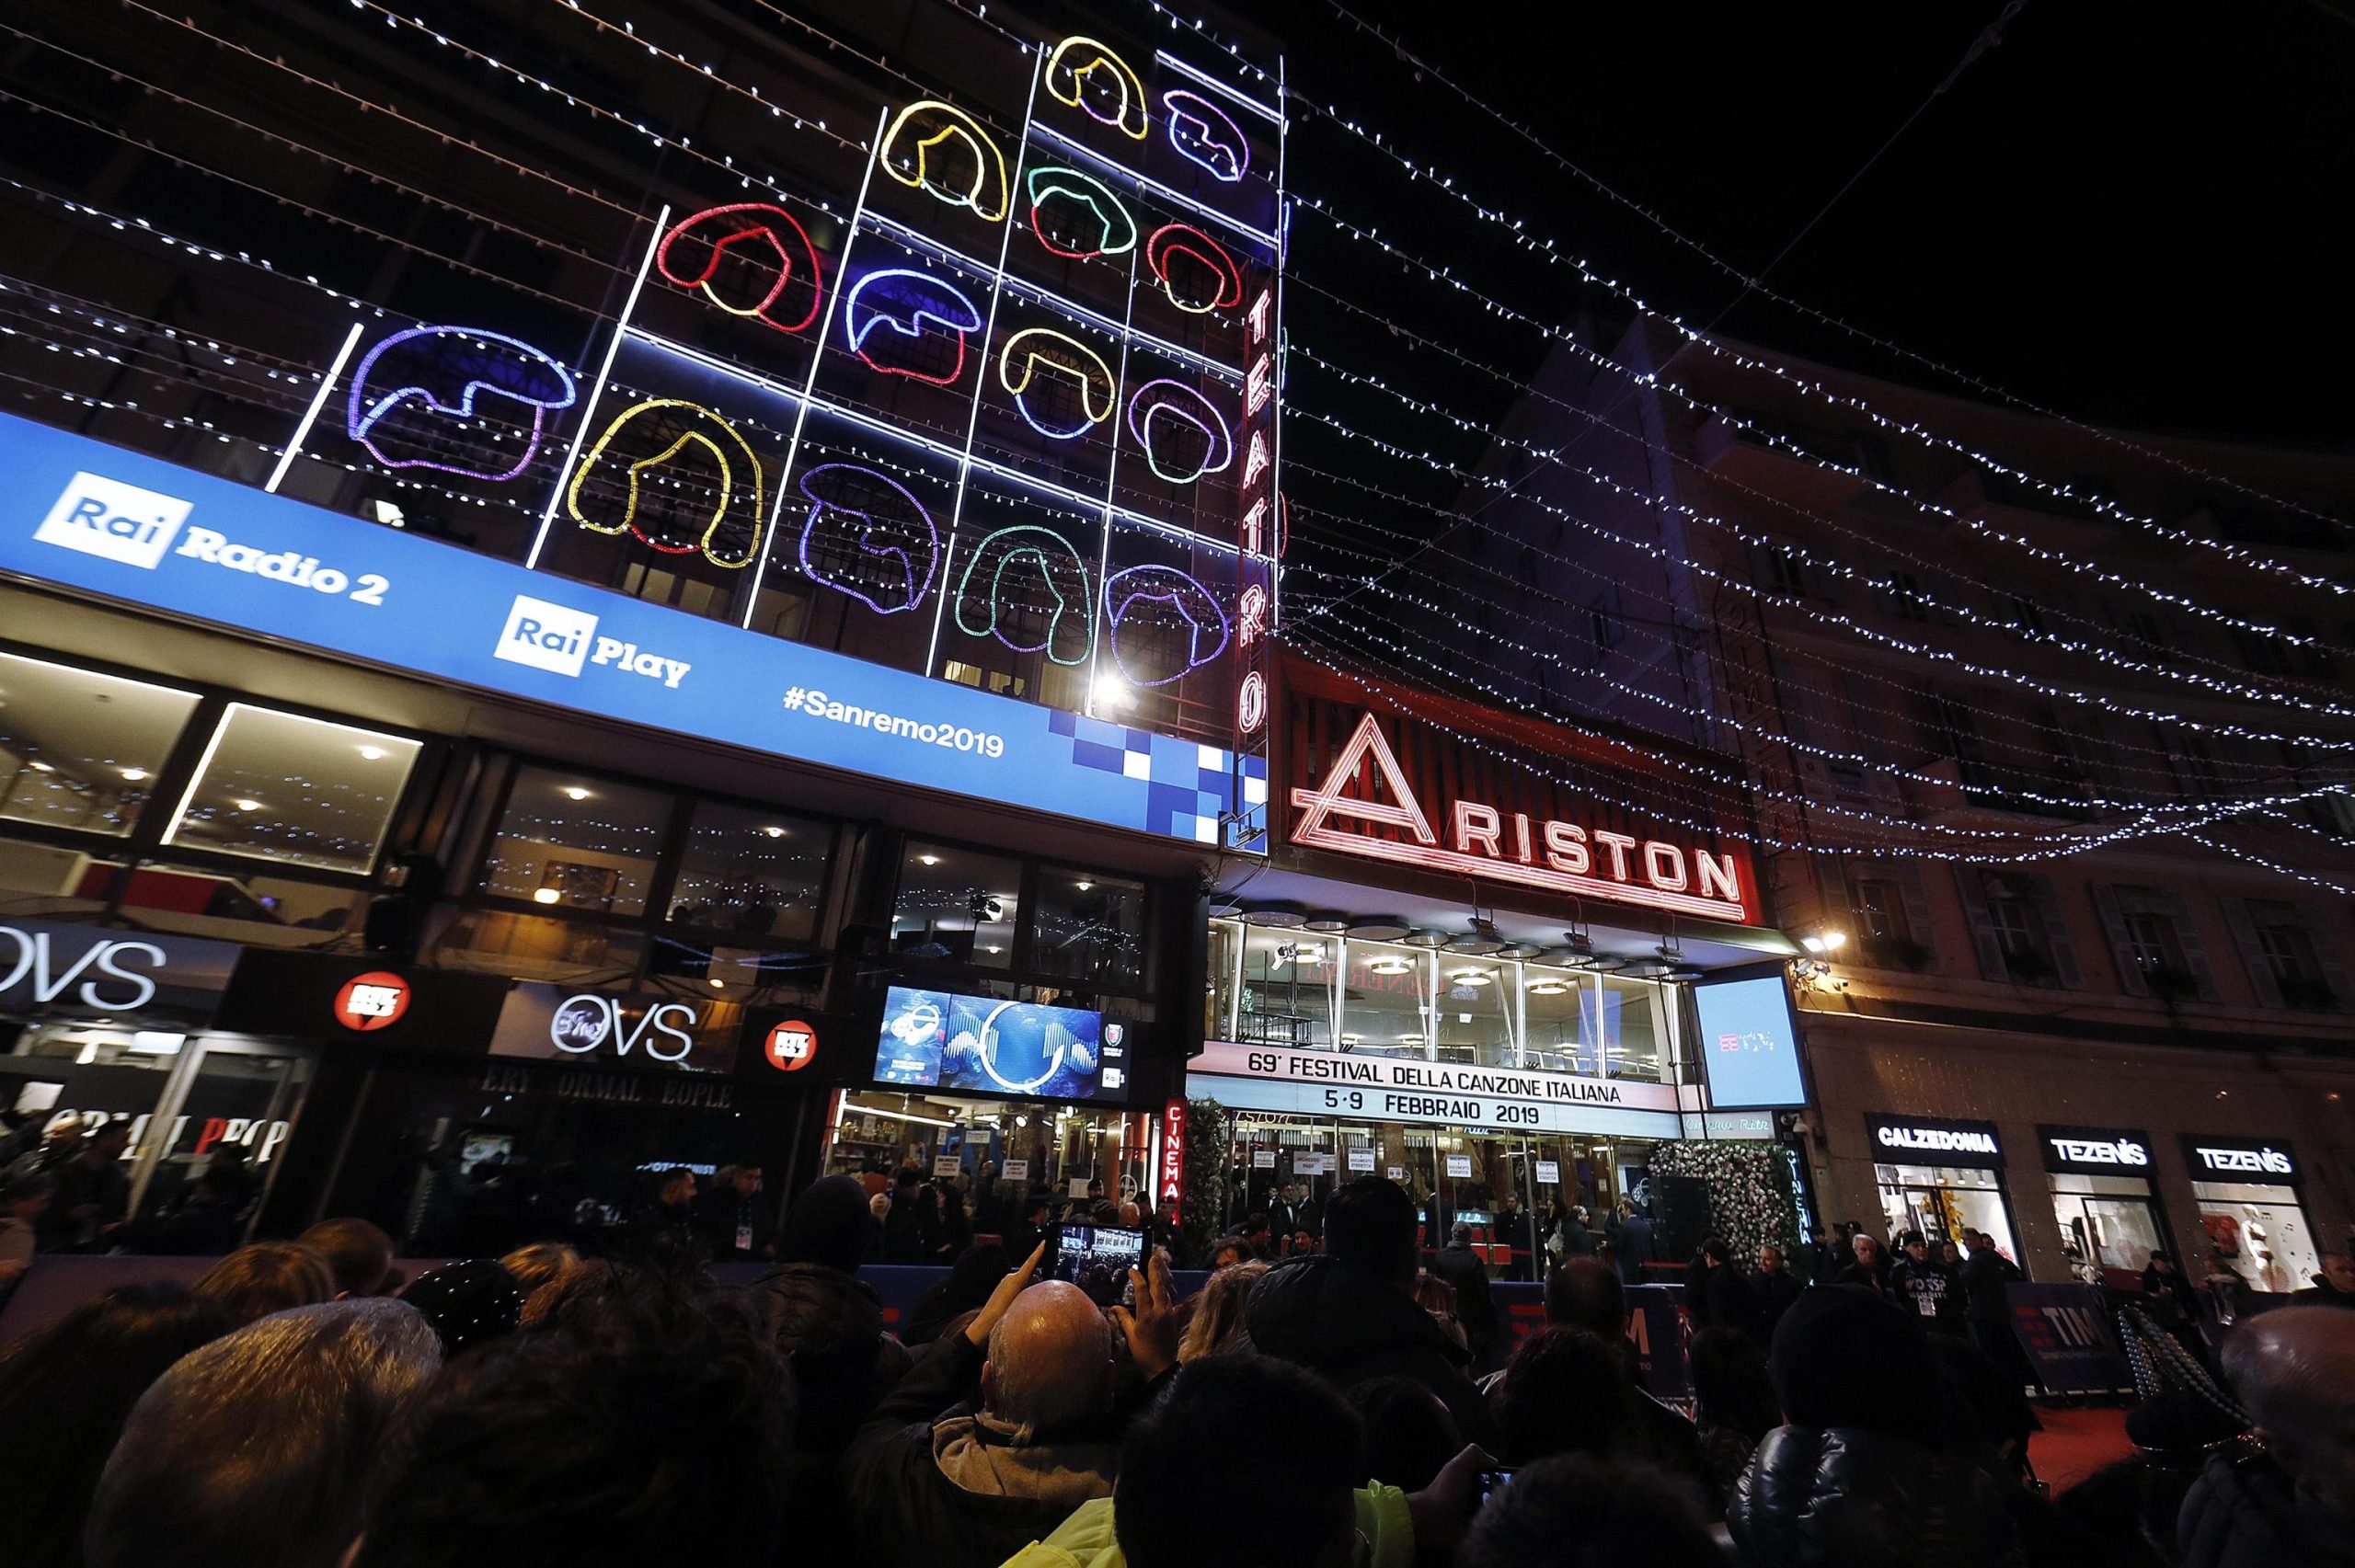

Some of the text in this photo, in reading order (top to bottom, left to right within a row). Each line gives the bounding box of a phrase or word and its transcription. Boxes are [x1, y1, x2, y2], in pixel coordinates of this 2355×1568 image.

[1238, 289, 1272, 735] TEATRO
[63, 498, 391, 606] Rai Radio 2
[513, 617, 690, 689] Rai Play
[783, 685, 1005, 759] #Sanremo2019
[1291, 713, 1744, 921] ARISTON
[551, 993, 696, 1061] OVS
[1289, 1057, 1384, 1082] FESTIVAL
[1393, 1067, 1453, 1088] DELLA
[1457, 1072, 1542, 1096] CANZONE
[1547, 1082, 1622, 1103] ITALIANA
[1385, 1094, 1480, 1119] FEBBRAIO
[1496, 1105, 1539, 1124] 2019
[1164, 1106, 1181, 1198] CINEMA
[1878, 1127, 1997, 1153] CALZEDONIA
[2051, 1138, 2148, 1165] TEZENIS
[2196, 1147, 2292, 1173] TEZENIS
[2040, 1307, 2107, 1345] TIM
